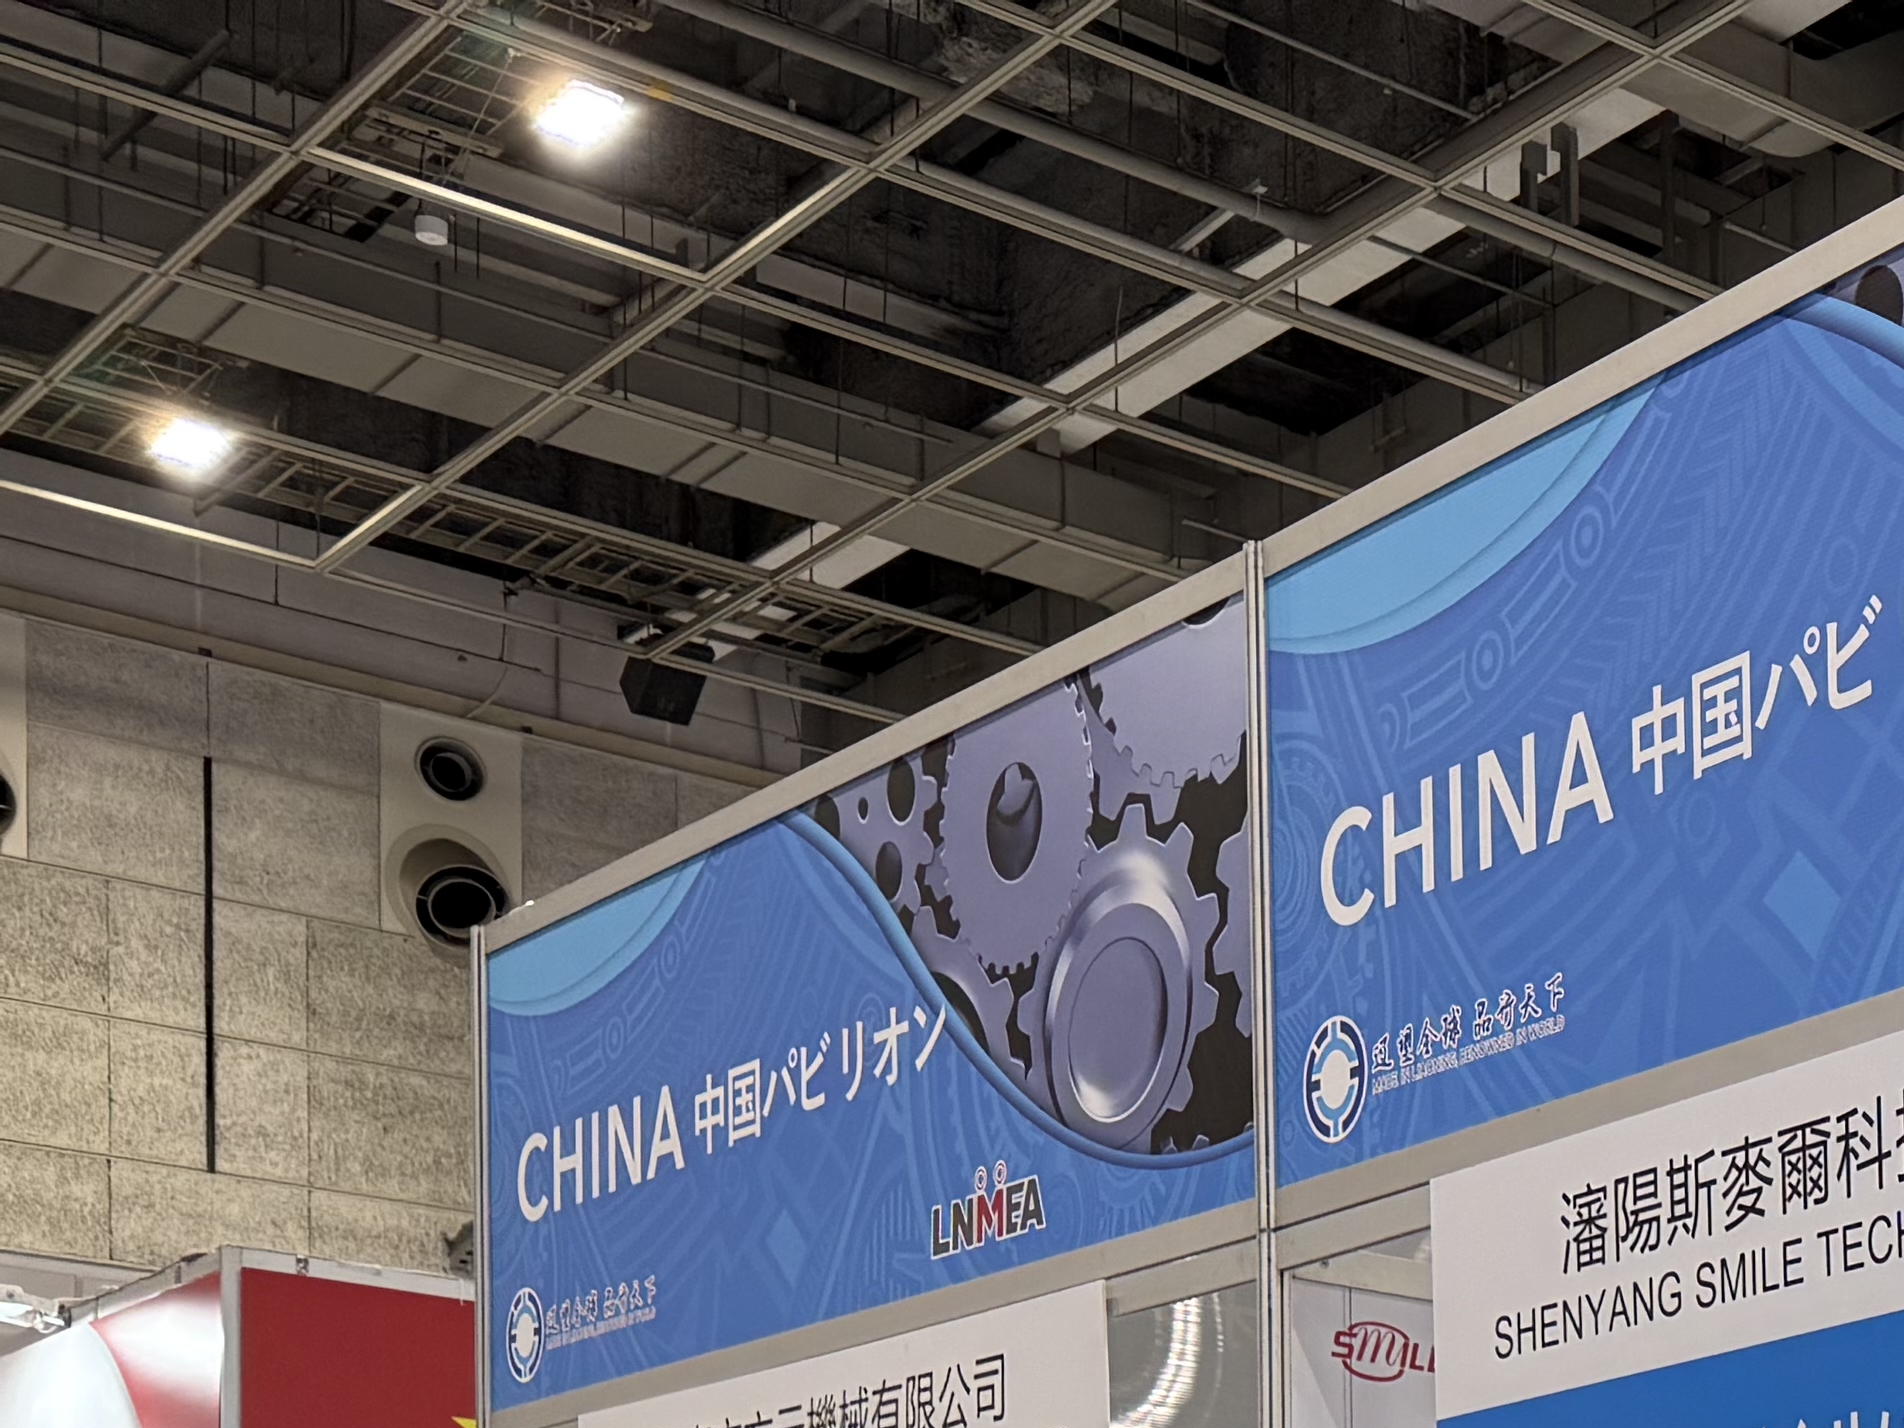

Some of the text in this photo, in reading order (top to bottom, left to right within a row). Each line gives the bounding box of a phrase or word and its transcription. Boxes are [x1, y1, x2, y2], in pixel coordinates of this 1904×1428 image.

[1320, 710, 1614, 926] CHINA
[694, 1003, 946, 1155] 中国パビリオン
[517, 1085, 685, 1221] CHINA
[1494, 1272, 1682, 1362] SHENYANG
[1695, 1238, 1801, 1327] SMILE
